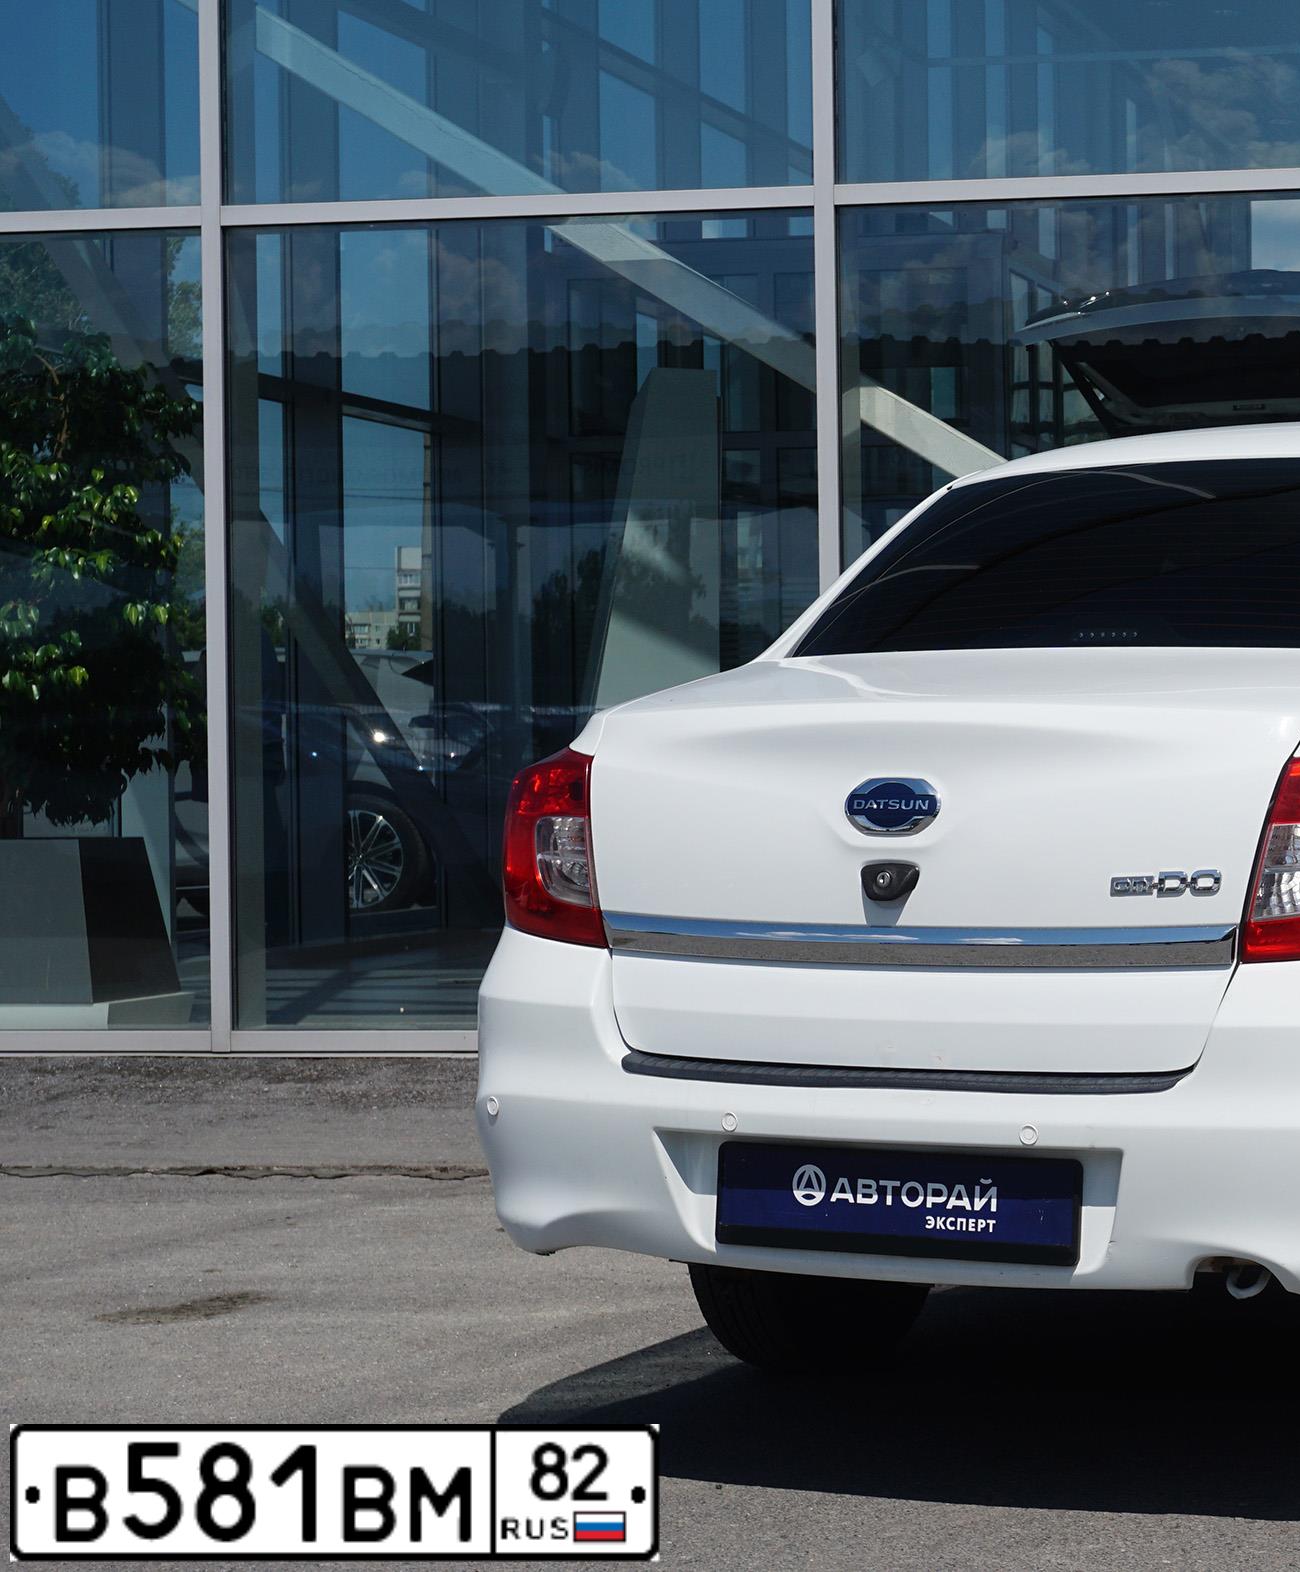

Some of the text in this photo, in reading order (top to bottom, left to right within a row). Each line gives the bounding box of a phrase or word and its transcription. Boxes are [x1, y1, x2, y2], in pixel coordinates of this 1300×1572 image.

[853, 799, 929, 811] DATSUN
[829, 1176, 998, 1213] АВТОРАЙ
[924, 1215, 997, 1233] ЭКСПЕРТ
